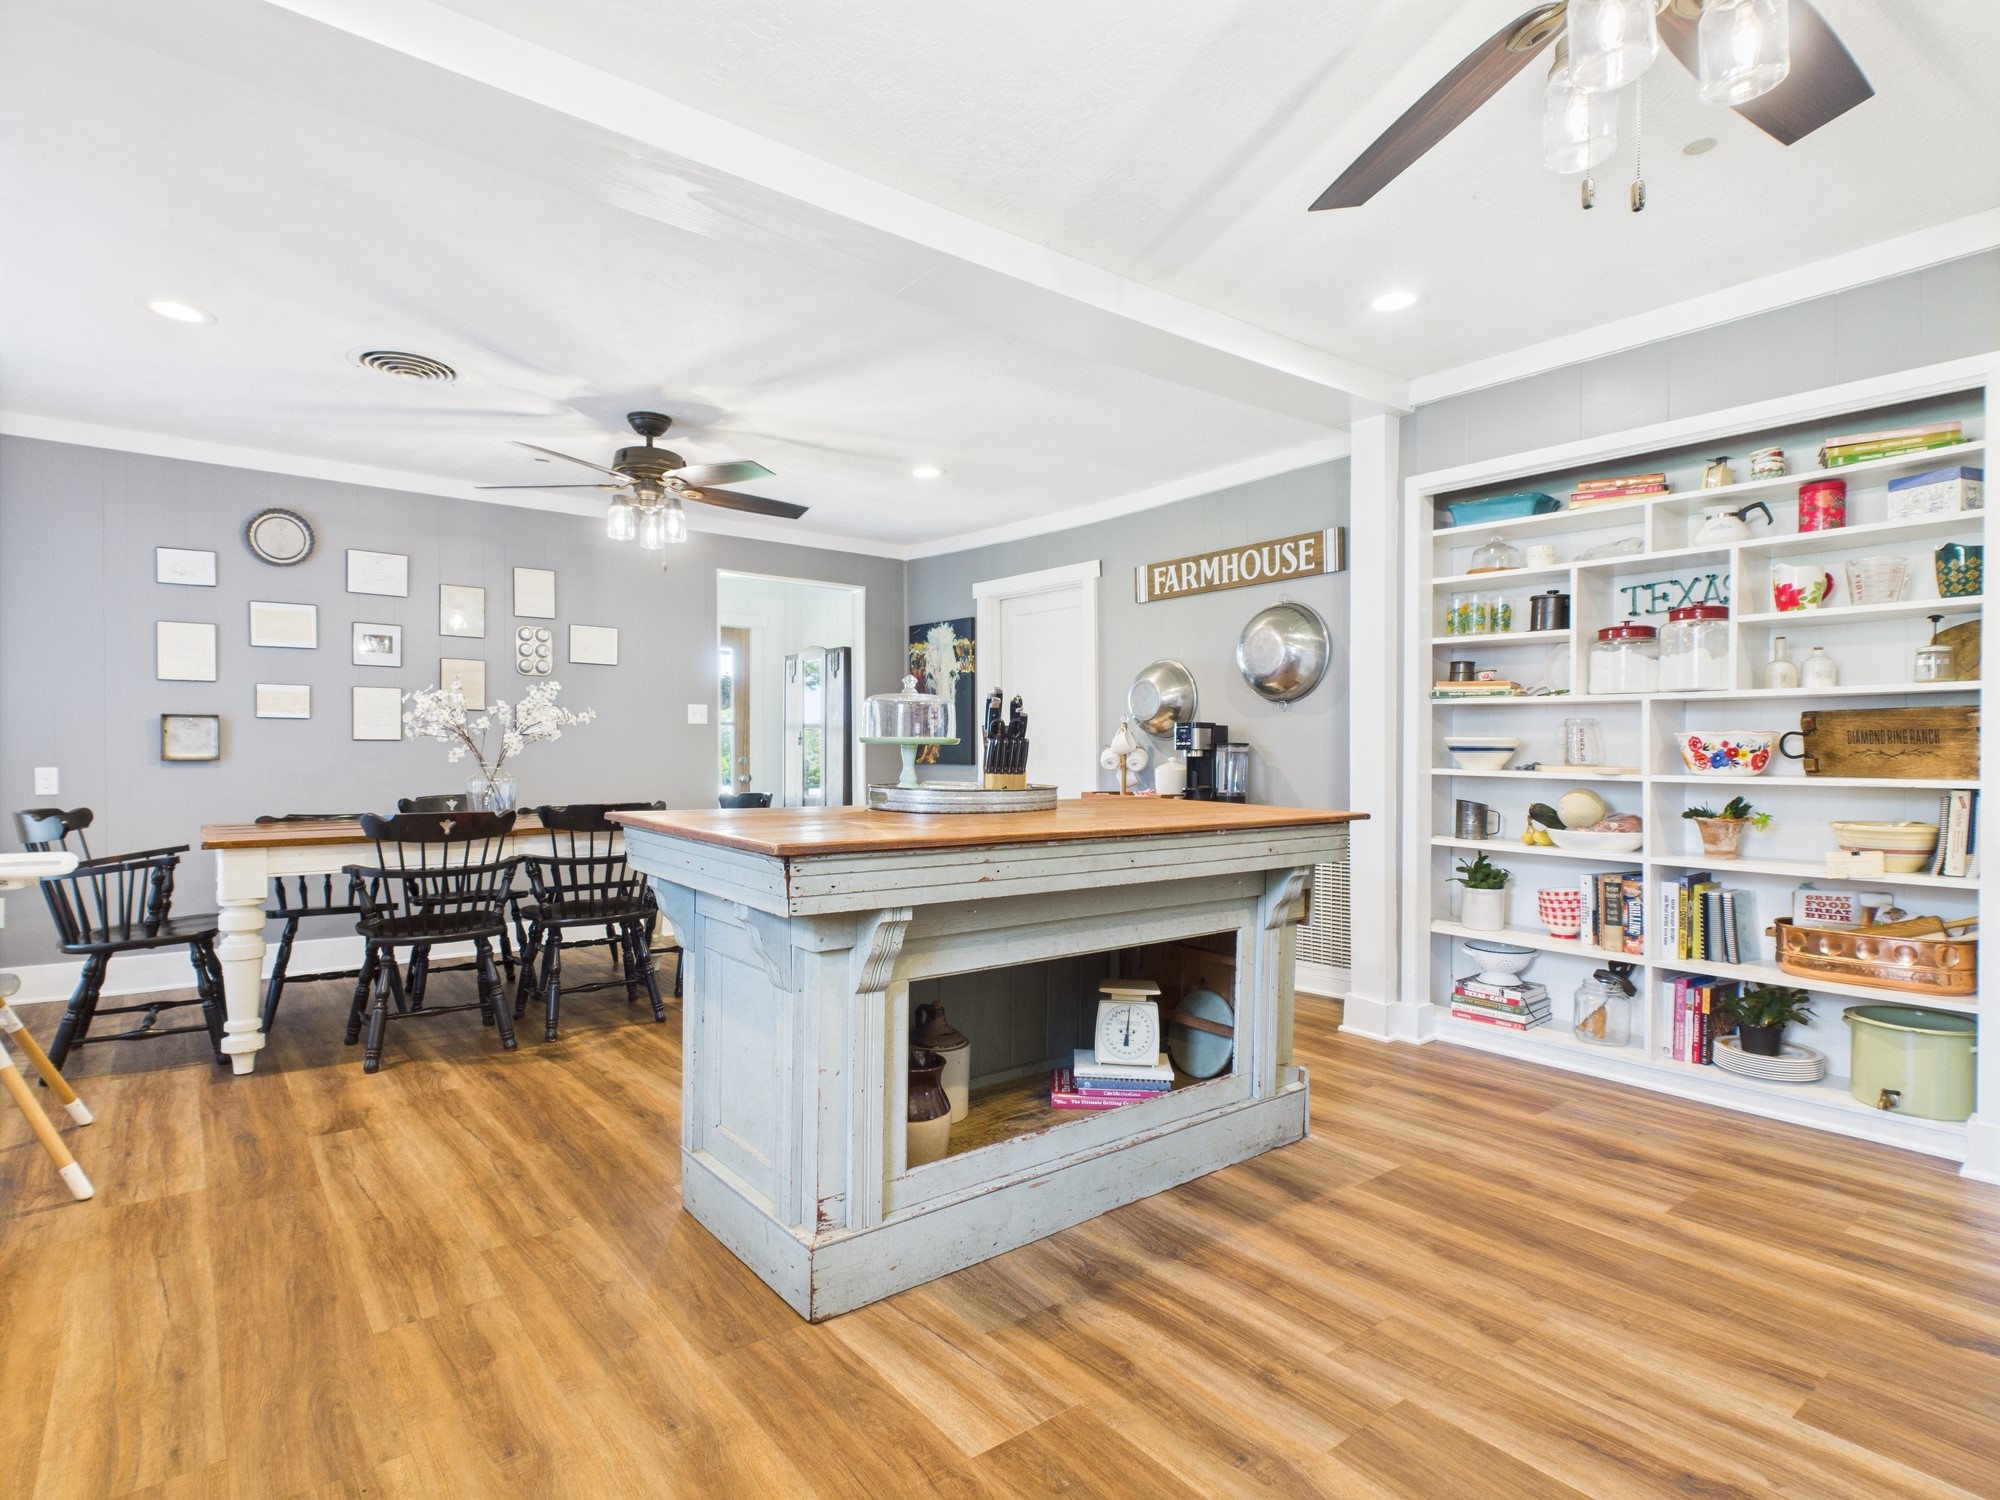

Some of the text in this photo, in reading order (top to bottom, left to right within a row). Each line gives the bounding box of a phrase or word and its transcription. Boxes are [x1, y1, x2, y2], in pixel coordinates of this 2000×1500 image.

[1153, 538, 1315, 595] FARMHOUSE
[1847, 728, 1940, 744] DIAMOND RING RANCH
[1805, 894, 1852, 902] GREAT
[1805, 901, 1851, 909] FOOD
[1805, 907, 1852, 915] GREAT
[1628, 902, 1642, 935] GRILLING
[1805, 912, 1851, 922] BEER
[1465, 990, 1486, 999] TEXAS
[1489, 995, 1507, 1003] EATS
